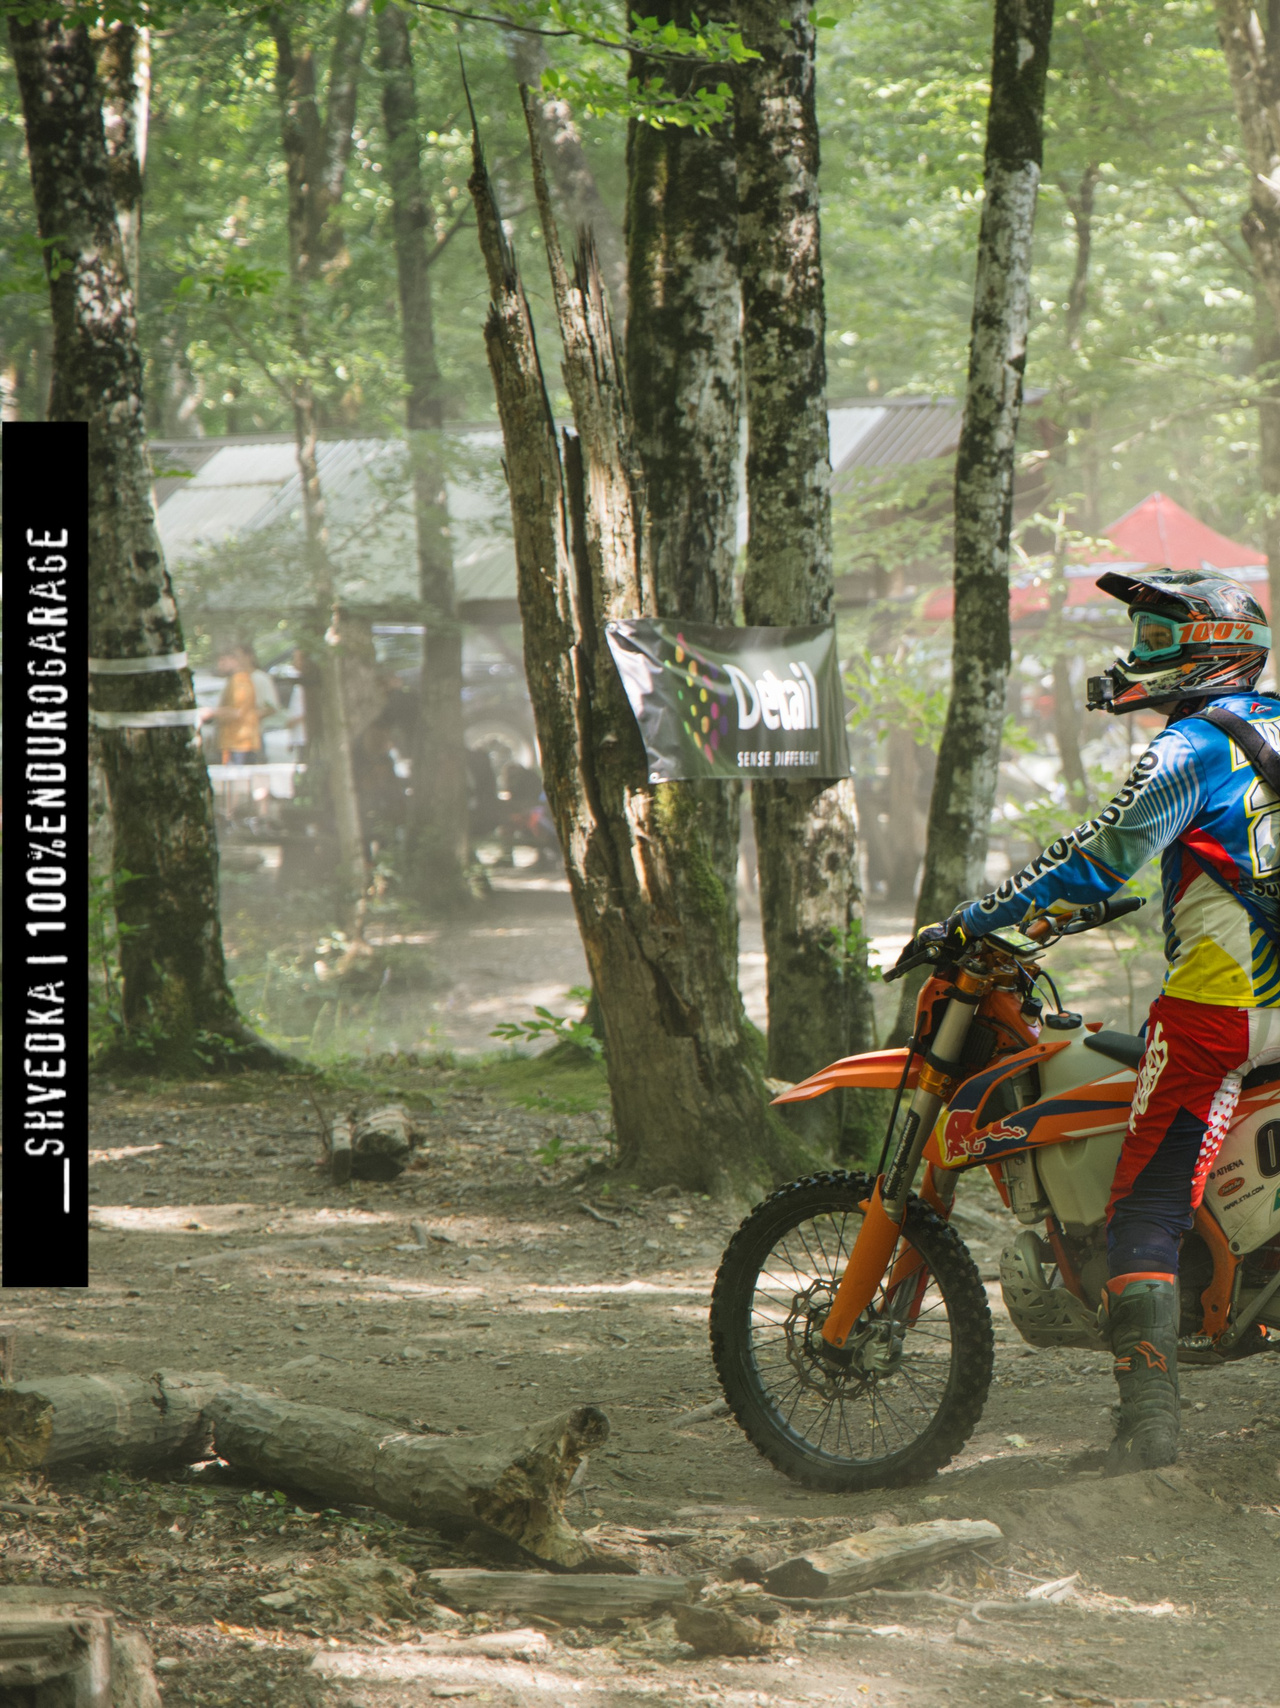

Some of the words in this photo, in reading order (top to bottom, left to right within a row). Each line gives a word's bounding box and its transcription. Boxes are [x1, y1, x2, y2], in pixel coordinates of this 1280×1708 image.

[1178, 622, 1254, 643] 100%
[722, 661, 819, 730] Detail
[737, 751, 771, 767] SENSE
[774, 750, 819, 767] DIFFERENT
[1217, 1159, 1245, 1177] ATHENA
